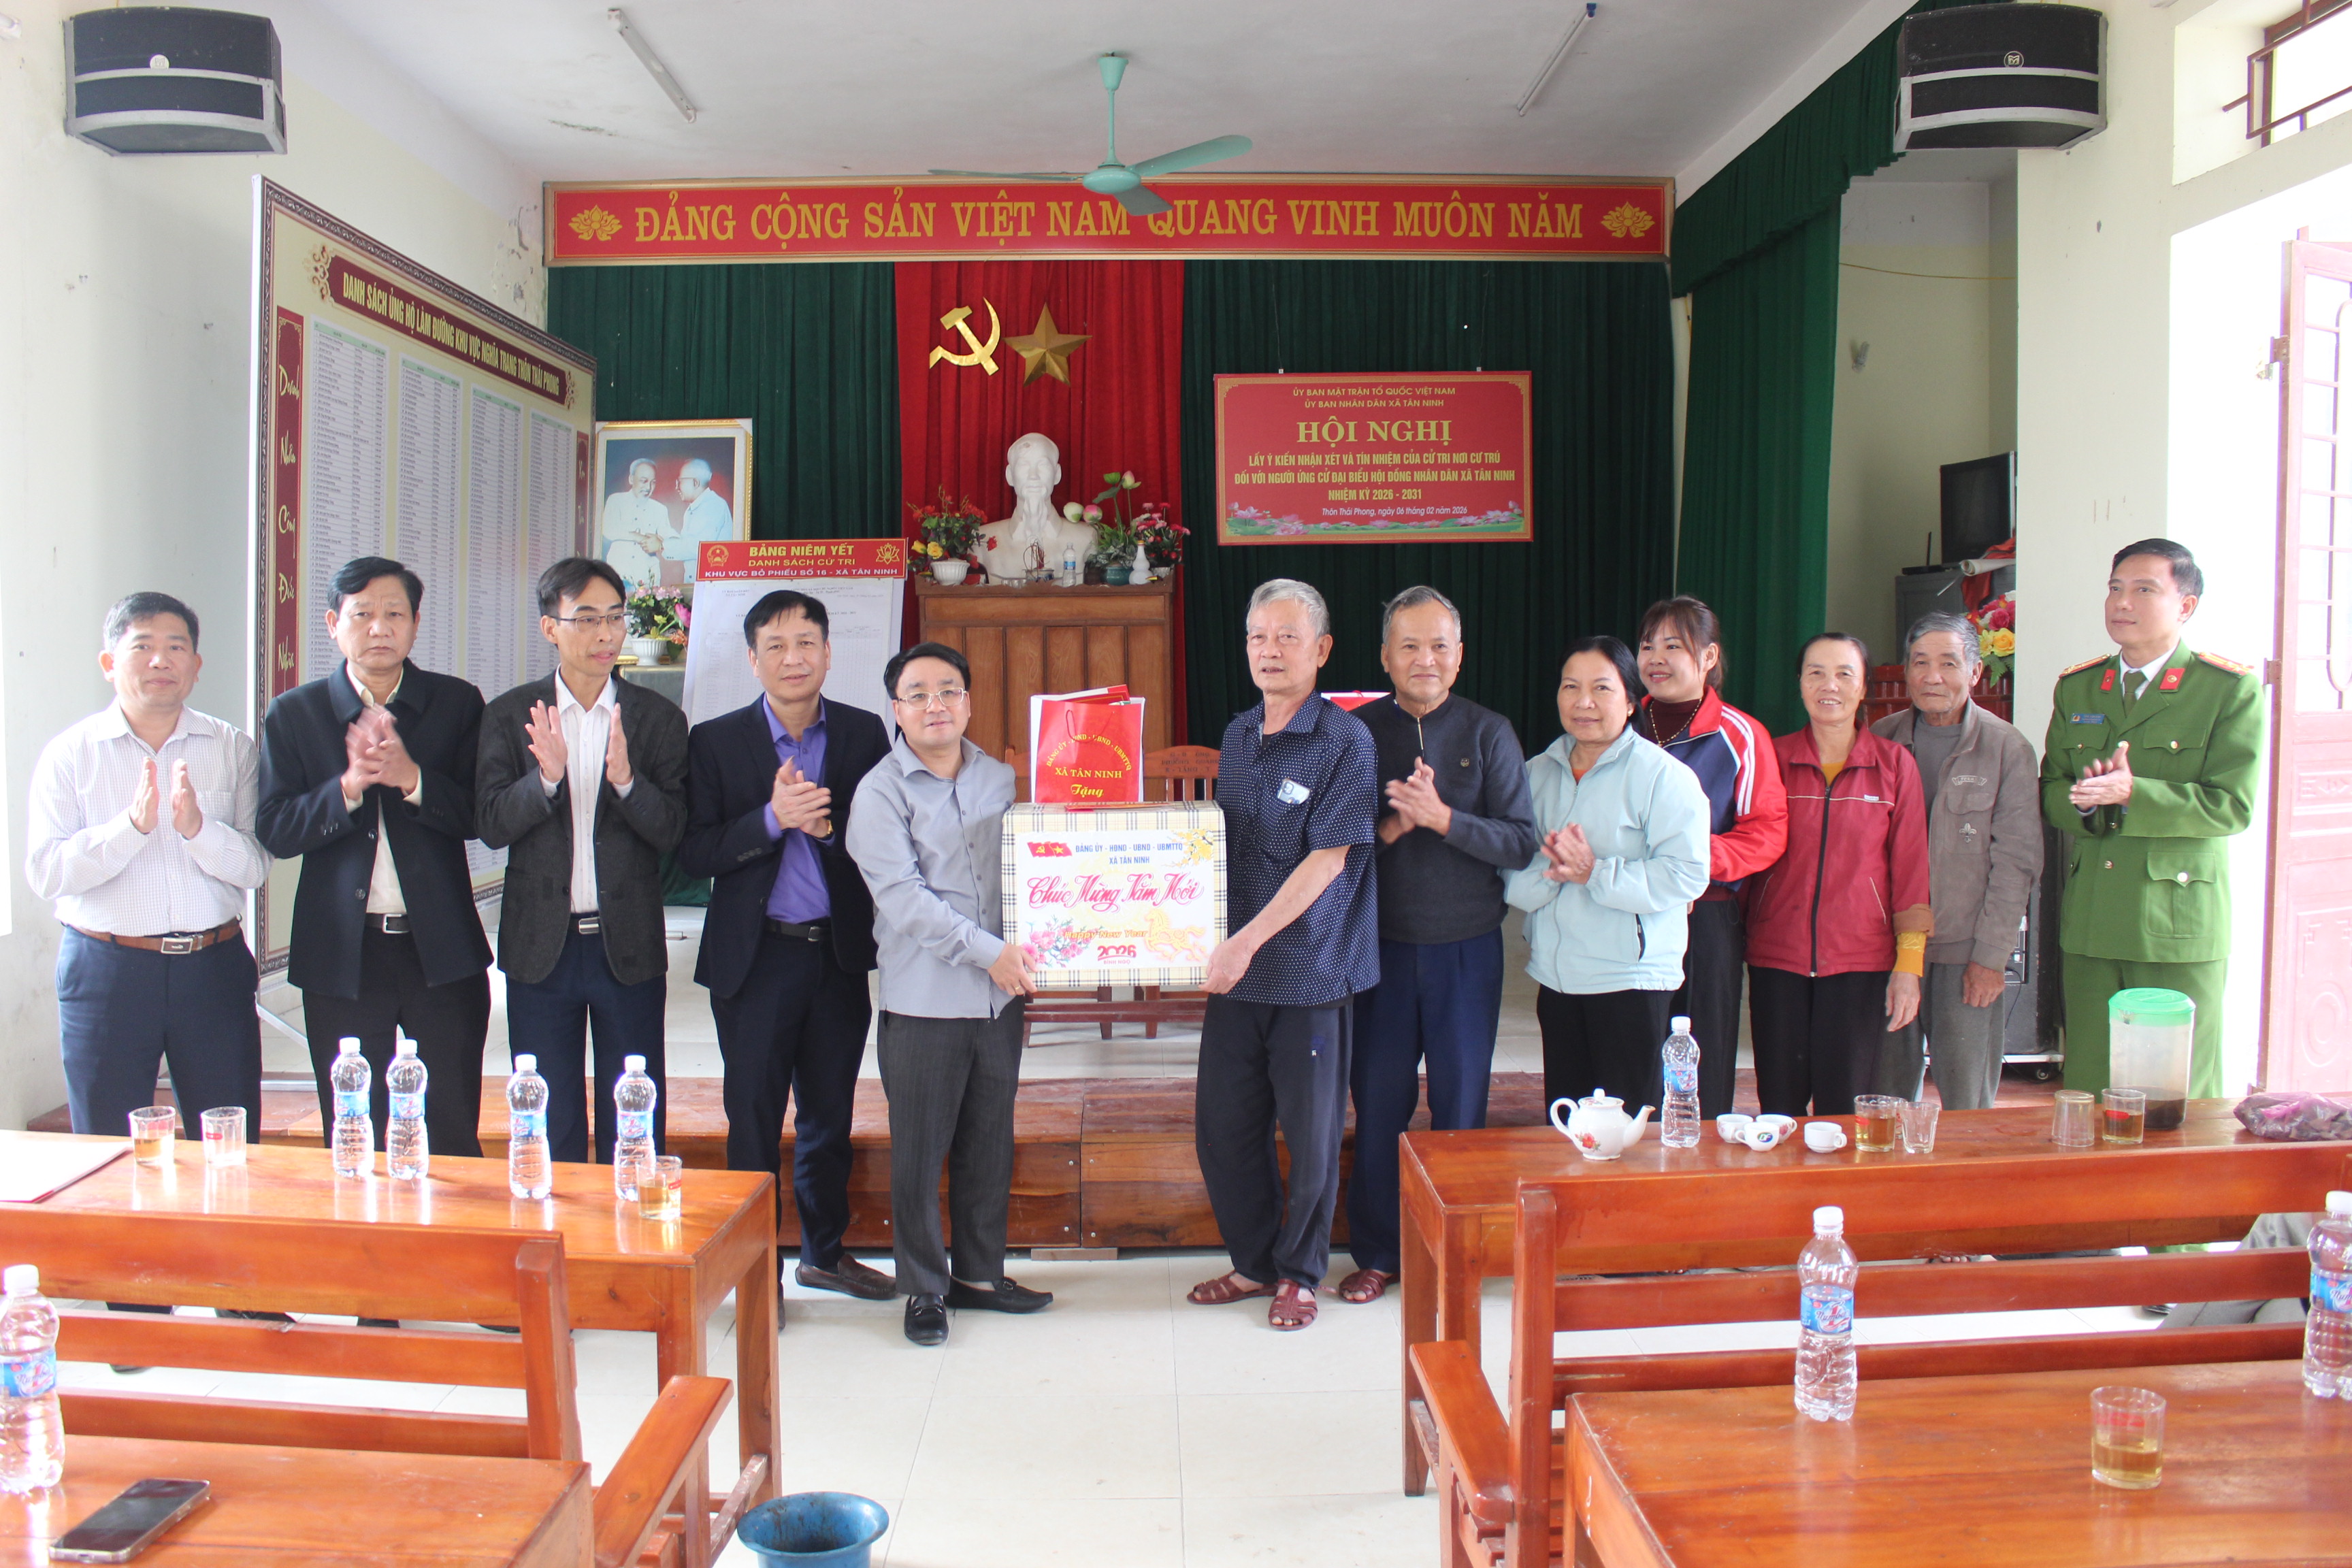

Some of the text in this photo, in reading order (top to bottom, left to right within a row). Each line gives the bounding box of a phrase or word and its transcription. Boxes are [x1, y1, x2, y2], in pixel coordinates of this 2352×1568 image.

[635, 186, 1583, 249] ĐẢNG CỘNG SẢN VIỆT NAM QUANG VINH MUÔN NĂM
[343, 272, 365, 306] DANH
[367, 282, 387, 316] SÁCH
[389, 287, 404, 325] ỦNG
[406, 301, 416, 334] HỘ
[416, 306, 431, 337] LÀM
[432, 315, 455, 348] ĐƯỜNG
[455, 327, 468, 354] KHU
[469, 335, 480, 363] VỰC
[500, 349, 517, 377] TRANG
[518, 357, 532, 384] THÔN
[532, 364, 543, 389] THÁI
[544, 370, 559, 396] PHONG
[1293, 387, 1305, 396] ỦY
[1348, 387, 1370, 397] TRẬN
[1372, 385, 1383, 395] TỔ
[1386, 385, 1413, 395] QUỐC
[1415, 386, 1433, 397] VIỆT
[1305, 399, 1316, 408] ỦY
[1339, 398, 1365, 407] NHÂN
[1367, 398, 1386, 407] DÂN
[1389, 398, 1401, 407] XÃ
[1403, 397, 1420, 407] TÂN
[1296, 415, 1452, 448] HỘI NGHỊ
[1249, 448, 1501, 468] LẤY Ý KIẾN NHẬN XÉT VÀ TÍN NHIỆM CỦA CỬ TRI NƠI CƯ TRÚ
[1235, 468, 1515, 485] ĐỐI VỚI NGƯỜI ỨNG CỬ ĐẠI BIỂU HỘI ĐỒNG NHÂN DÂN XÃ TÂN NINH
[1328, 487, 1357, 503] NHIỆM
[1359, 487, 1371, 500] KỲ
[1373, 489, 1394, 500] 2026
[1402, 489, 1422, 500] 2031
[1322, 508, 1338, 516] Thôn
[1339, 508, 1353, 516] Thái
[1354, 507, 1377, 517] Phong,
[1378, 508, 1395, 517] ngày
[1406, 506, 1425, 517] tháng
[1436, 506, 1451, 514] năm
[1452, 506, 1467, 514] 2026
[749, 542, 854, 557] BẢNG NIÊM YẾT
[783, 557, 814, 566] SÁCH
[817, 557, 835, 566] CỬ
[751, 568, 766, 576] BỎ
[768, 568, 797, 576] PHIẾU
[800, 568, 814, 576] SỐ
[1114, 745, 1132, 771] UBMTTQ
[1071, 768, 1092, 777] TÂN
[1071, 784, 1104, 798] Tặng
[1075, 843, 1093, 853] ĐẢNG
[1095, 842, 1103, 852] ỦY
[1109, 857, 1118, 865] XÃ
[1120, 856, 1132, 864] TÂN
[1027, 872, 1203, 913] Chúc Mừng Năm Mới
[1064, 930, 1148, 940] Happy New Year
[1097, 945, 1137, 959] 2026
